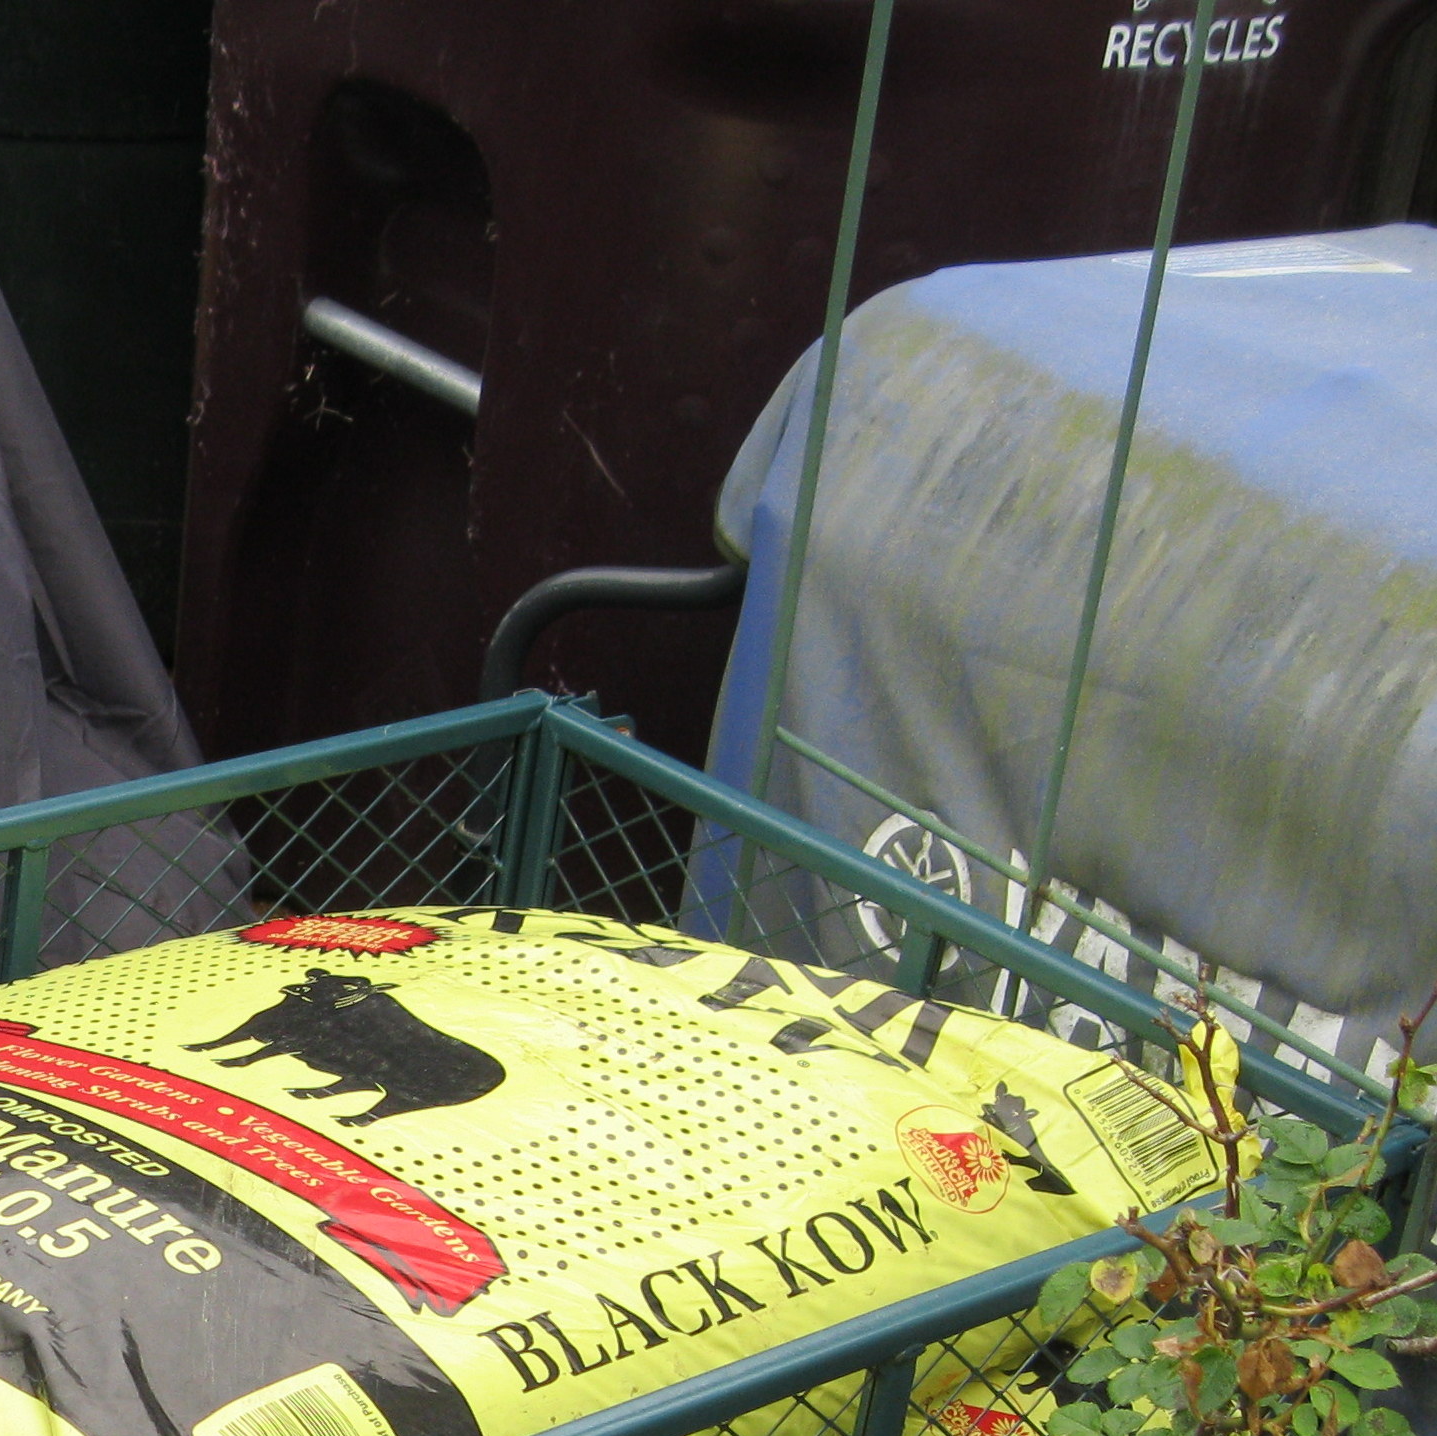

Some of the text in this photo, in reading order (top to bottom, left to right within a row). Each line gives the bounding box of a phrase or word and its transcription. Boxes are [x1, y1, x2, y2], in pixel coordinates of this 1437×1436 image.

[1102, 15, 1285, 69] RECYCLES
[294, 919, 413, 940] SPECIAL
[80, 1083, 184, 1122] Shrubs
[182, 1119, 247, 1147] and
[243, 1142, 325, 1189] Trees
[88, 1064, 205, 1106] Gardens
[237, 1114, 370, 1186] Vegetable
[369, 1186, 482, 1265] Gardens
[478, 1177, 932, 1393] BLACK KOW
[333, 1373, 374, 1417] Purchase
